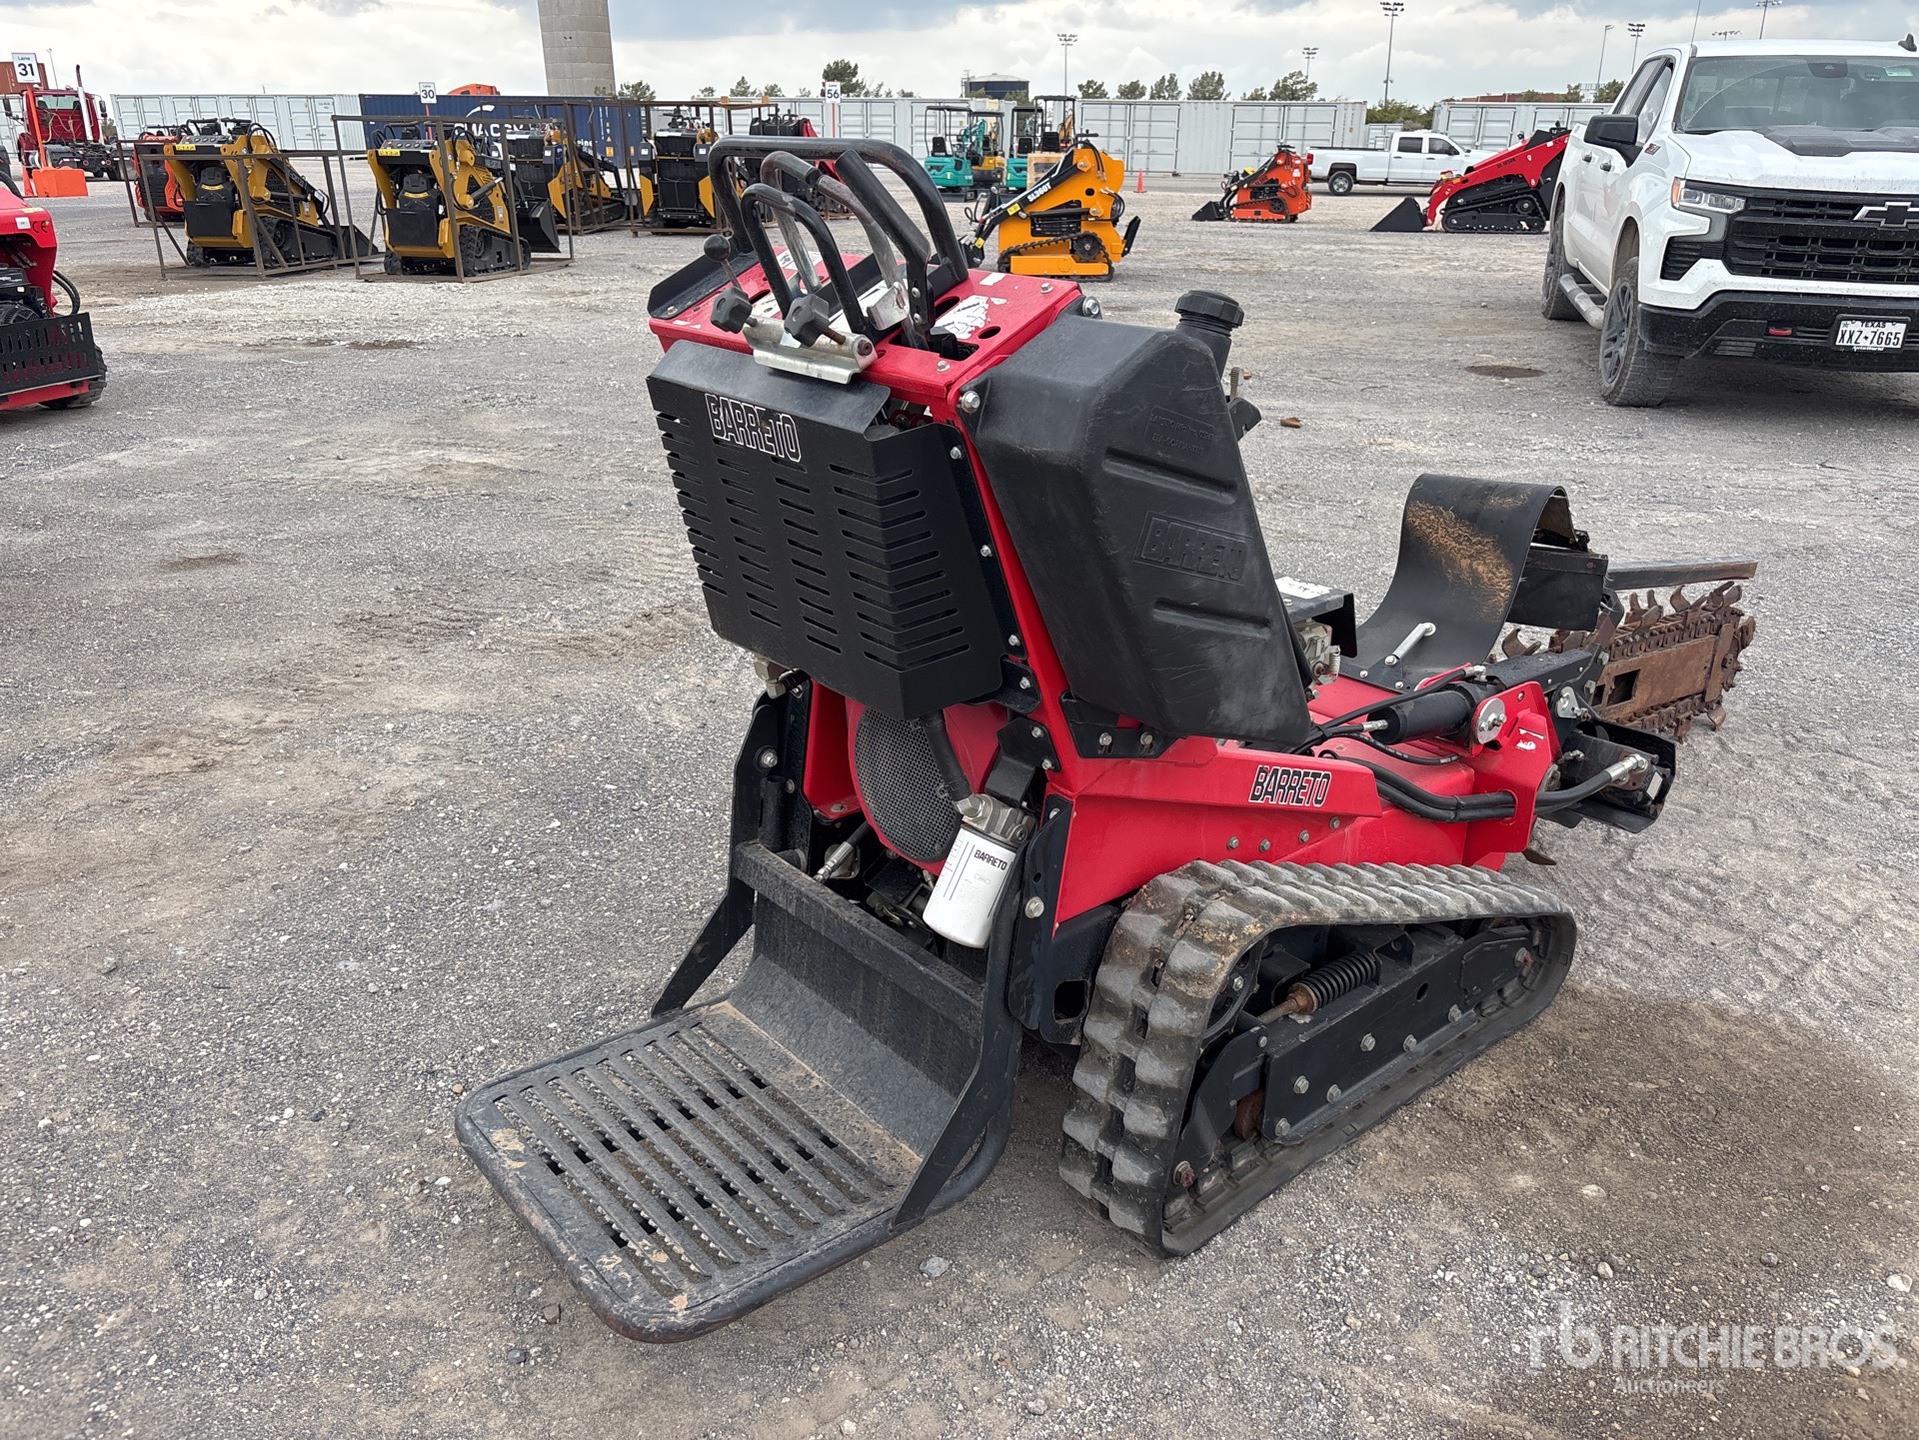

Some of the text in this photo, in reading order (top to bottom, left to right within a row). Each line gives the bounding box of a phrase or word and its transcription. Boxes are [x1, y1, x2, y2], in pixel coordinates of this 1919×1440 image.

[17, 62, 35, 77] 31
[421, 89, 434, 99] 30
[827, 89, 839, 99] 56
[705, 393, 802, 463] BARRETO
[1141, 517, 1246, 581] BARRETO
[1248, 765, 1332, 807] BARRETO
[974, 849, 1008, 871] BARRETO
